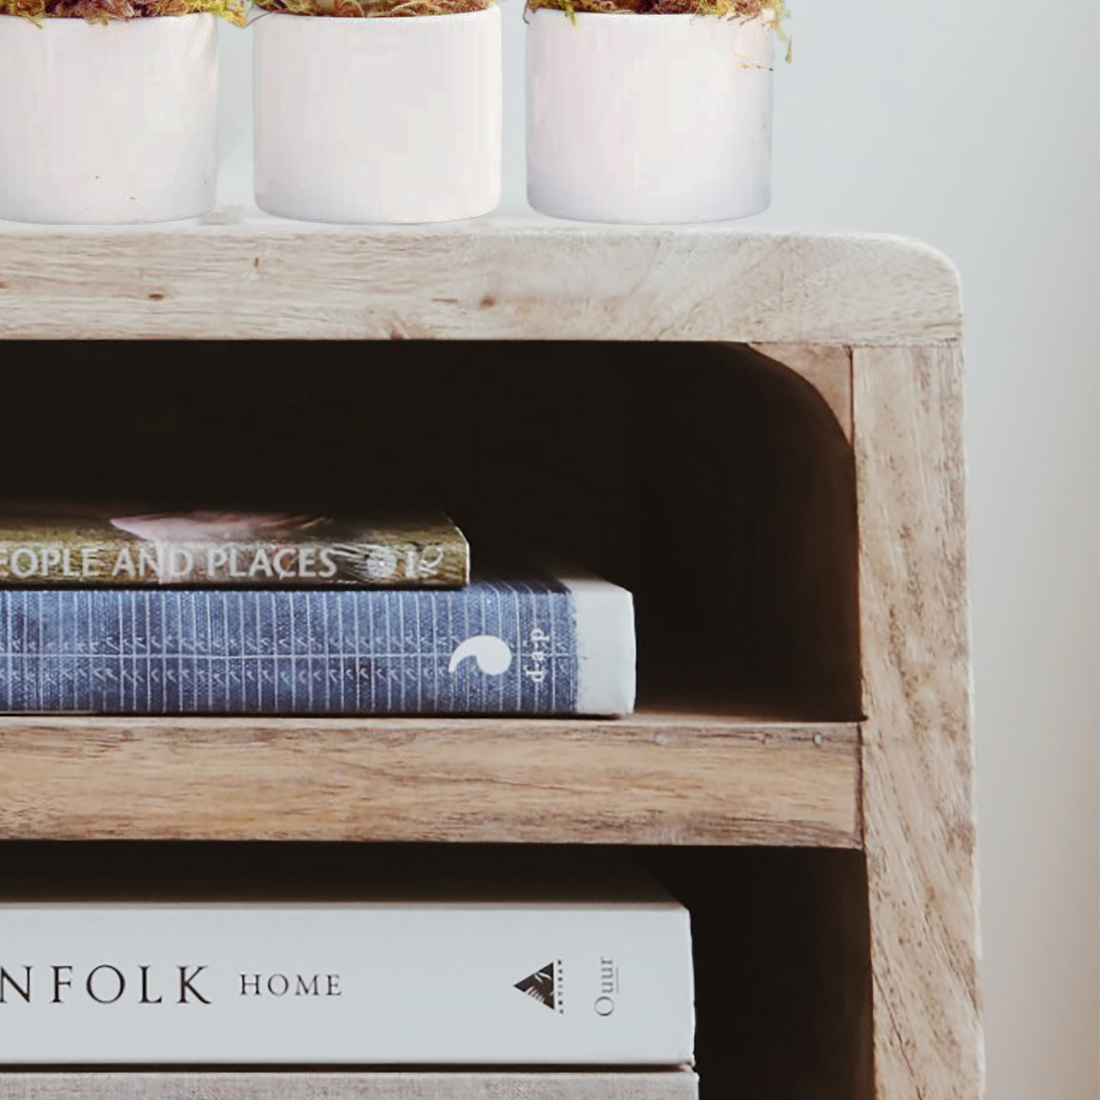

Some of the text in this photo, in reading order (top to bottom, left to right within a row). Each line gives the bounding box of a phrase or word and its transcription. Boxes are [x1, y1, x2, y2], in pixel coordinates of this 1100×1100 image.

[111, 547, 194, 580] AND
[206, 546, 338, 579] PLACES
[239, 973, 343, 997] HOME
[594, 955, 615, 1018] Ouur
